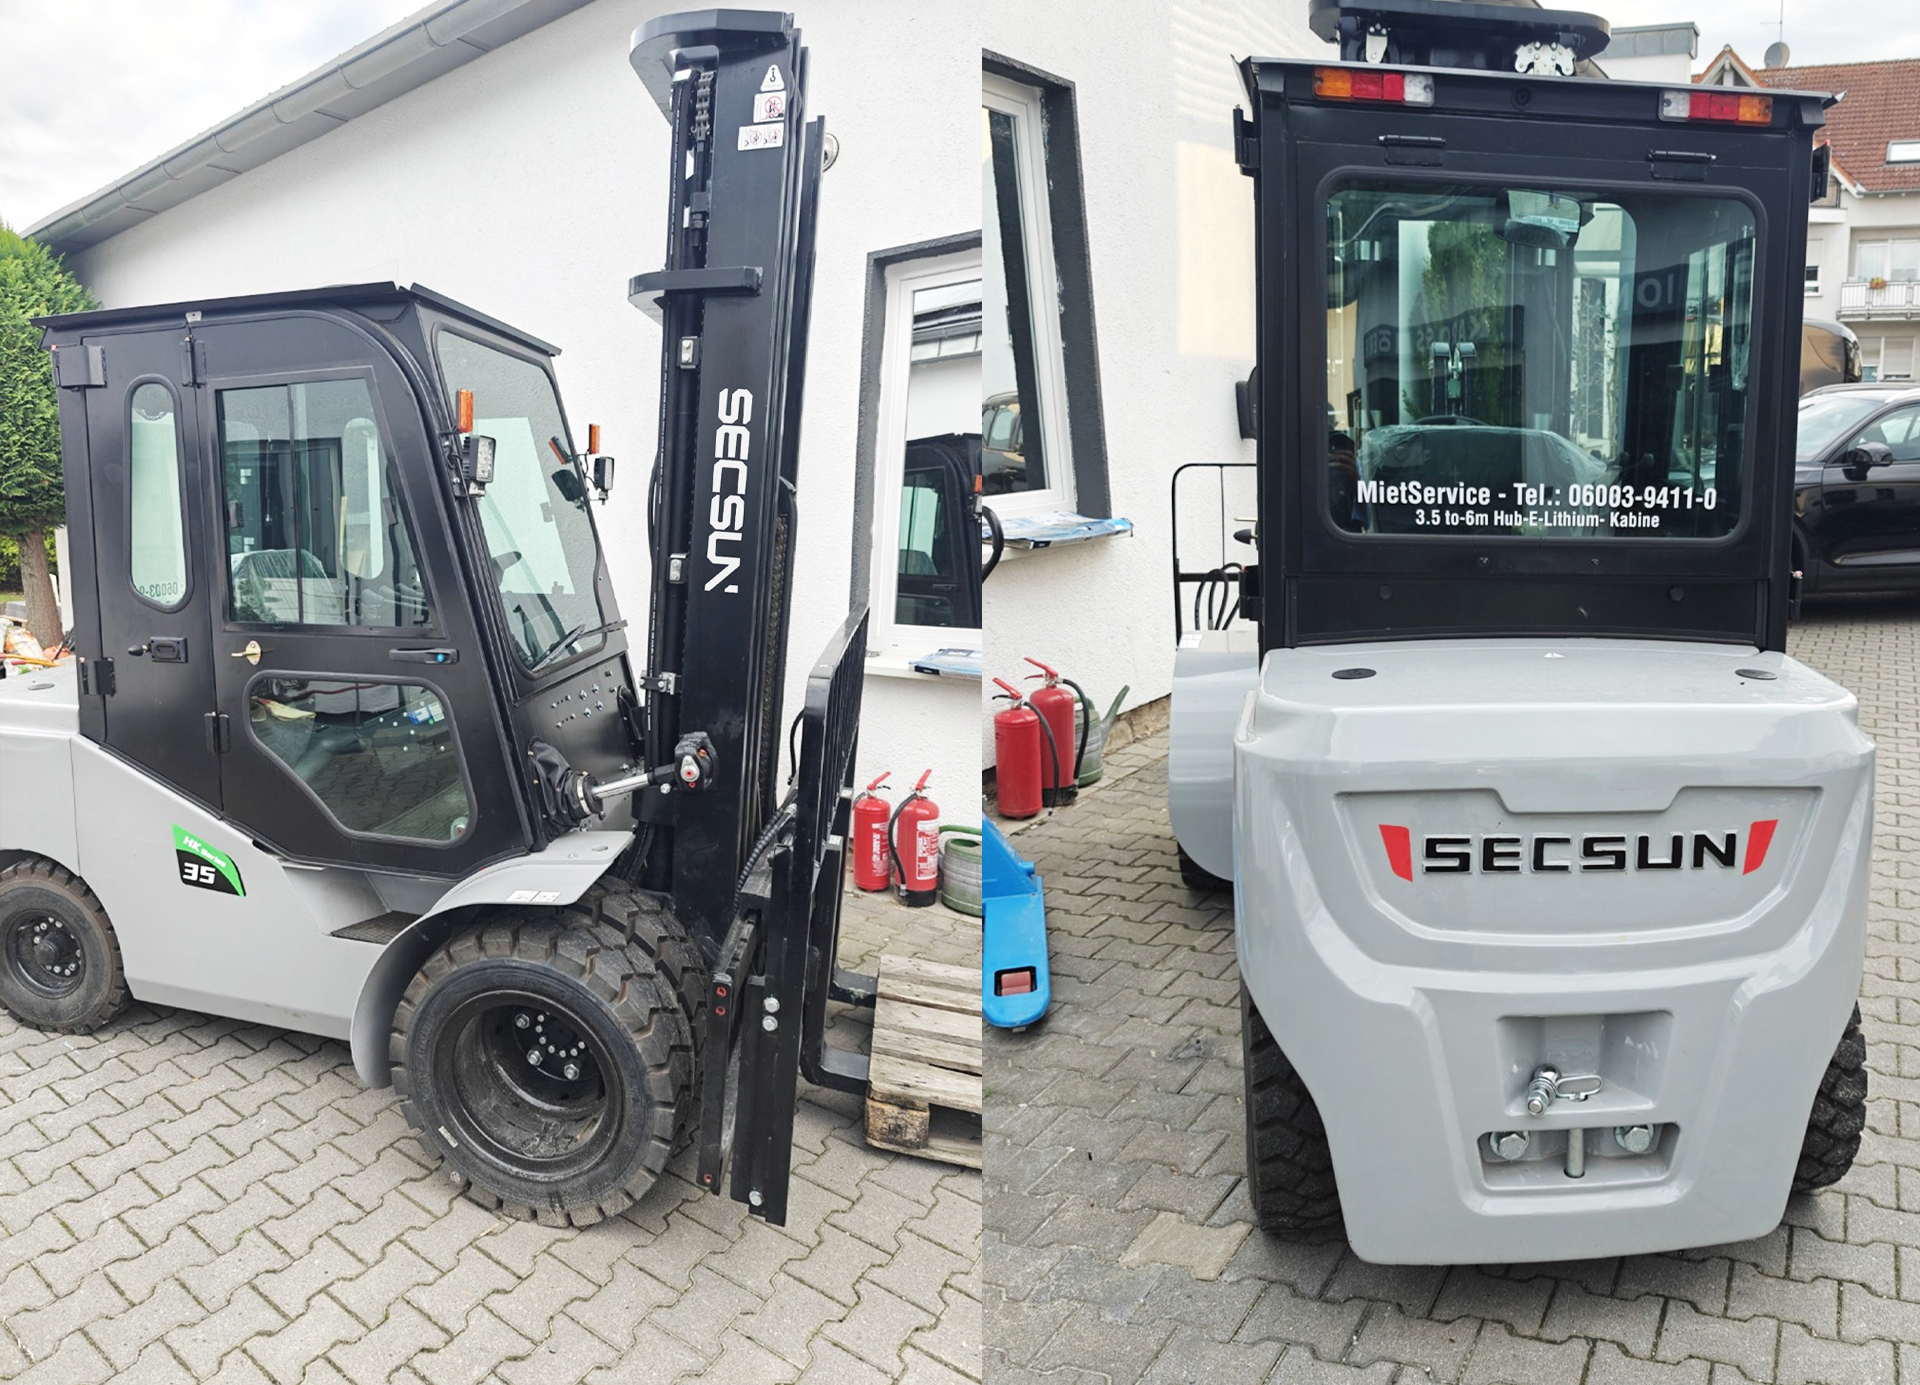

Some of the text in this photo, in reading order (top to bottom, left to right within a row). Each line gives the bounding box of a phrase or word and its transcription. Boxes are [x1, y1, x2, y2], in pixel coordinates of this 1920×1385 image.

[704, 388, 753, 594] SECSUN
[1357, 480, 1491, 506] MietService
[1513, 482, 1561, 506] Tel.:
[1568, 484, 1717, 510] 06003-9411-0
[1415, 509, 1660, 528] 3.5 to-6m Hub-E-Lithium- Kabine
[183, 836, 201, 852] HK
[1423, 830, 1738, 874] SECSUN
[182, 862, 216, 884] 35
